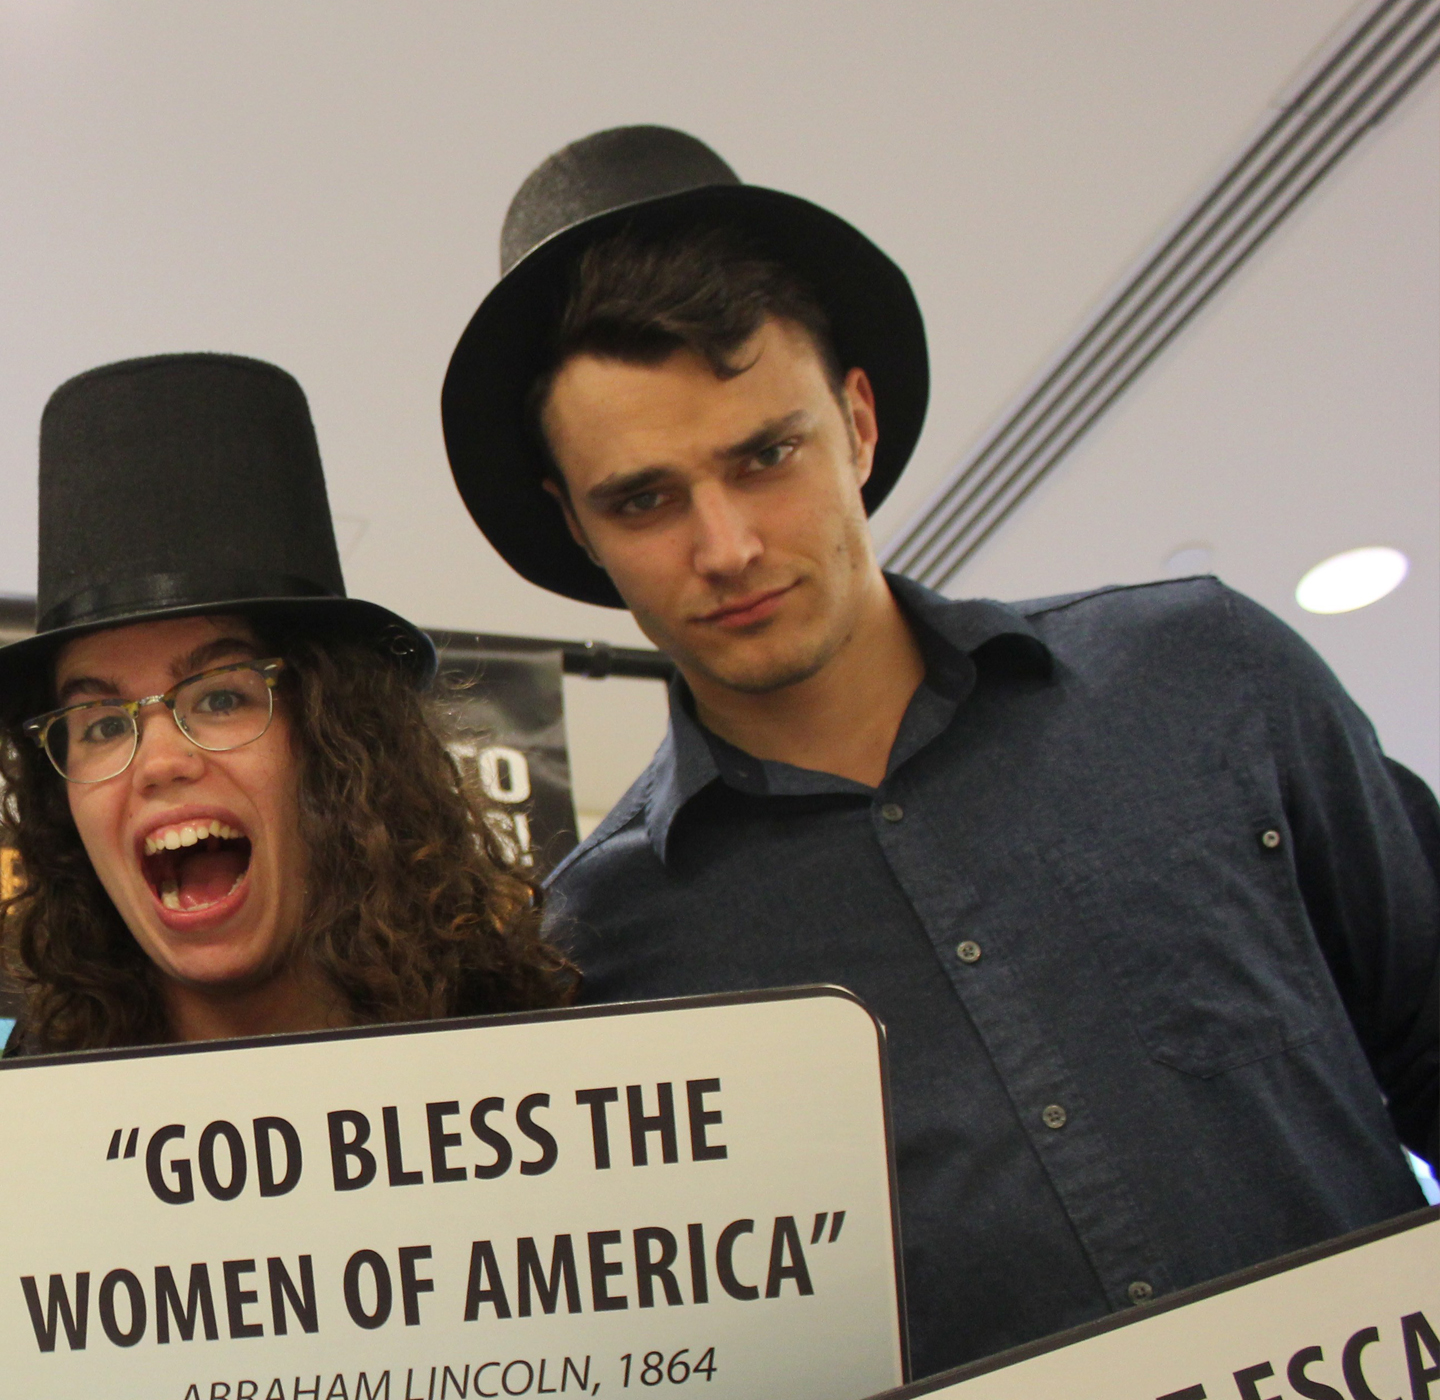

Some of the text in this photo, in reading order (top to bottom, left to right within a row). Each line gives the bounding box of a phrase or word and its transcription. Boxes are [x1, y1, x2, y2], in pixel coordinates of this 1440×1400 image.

[106, 1077, 728, 1205] “GOD BLESS THE
[19, 1210, 846, 1353] WOMEN OF AMERICA”
[404, 1355, 602, 1400] LINCOLN,
[619, 1346, 719, 1388] 1864
